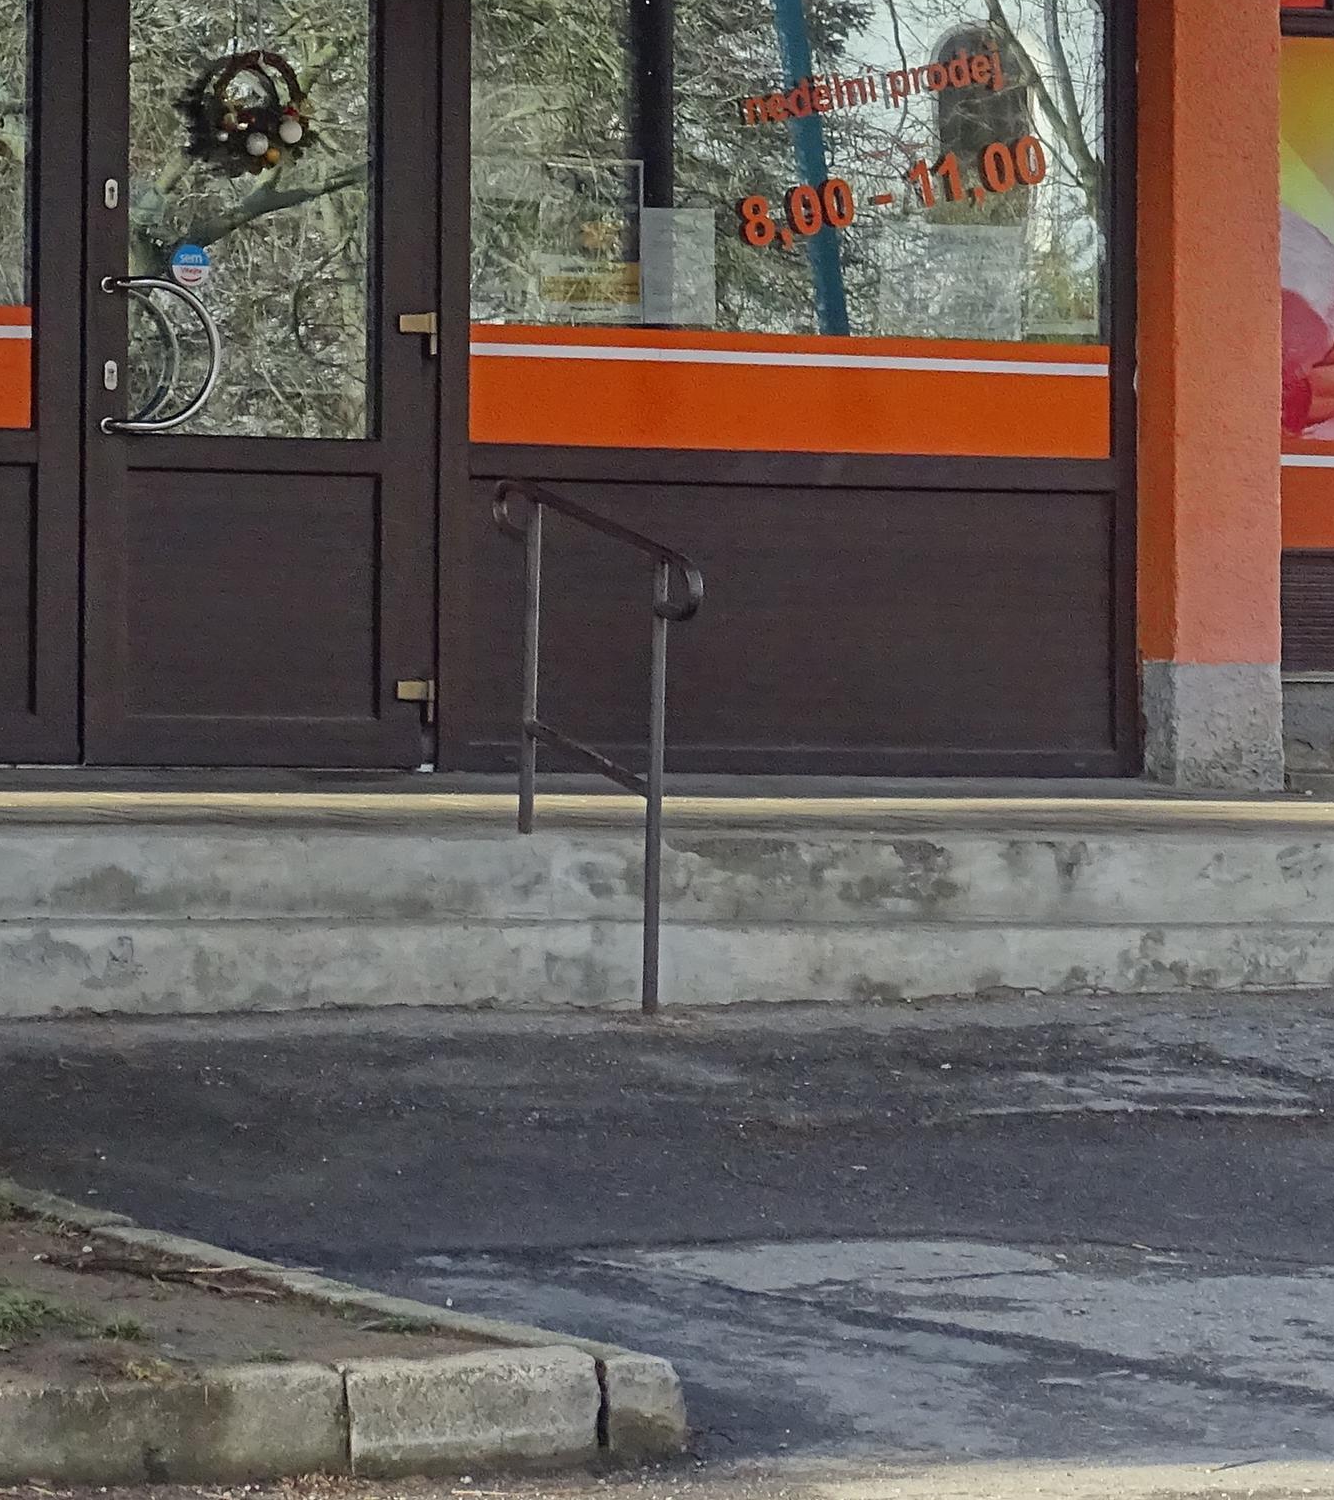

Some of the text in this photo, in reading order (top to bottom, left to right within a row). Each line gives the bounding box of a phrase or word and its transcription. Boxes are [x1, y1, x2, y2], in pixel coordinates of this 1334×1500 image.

[888, 42, 1004, 108] prodej
[741, 135, 1047, 250] 8,00 - 11,00
